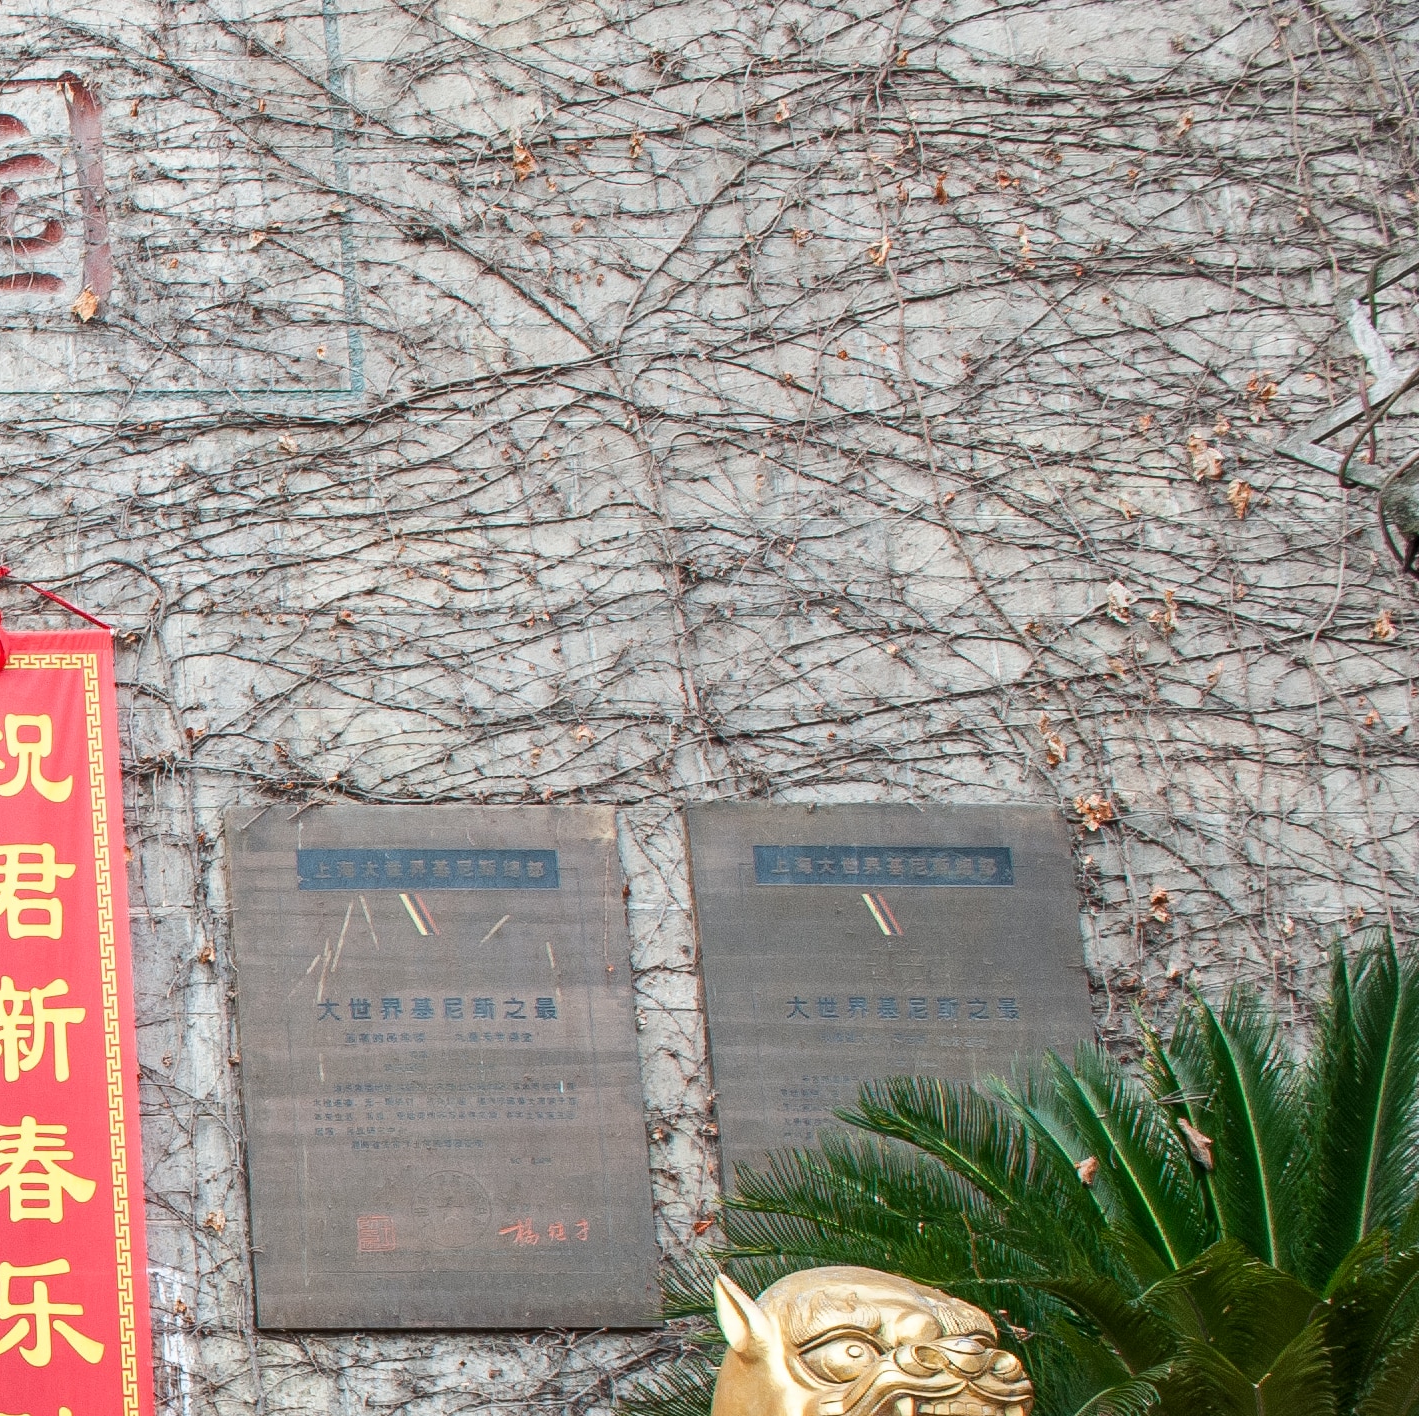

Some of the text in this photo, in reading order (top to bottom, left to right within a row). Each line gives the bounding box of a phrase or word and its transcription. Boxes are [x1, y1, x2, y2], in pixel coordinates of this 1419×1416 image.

[316, 996, 558, 1021] 大世界基尼斯之最
[786, 995, 1021, 1021] 大世界基尼斯之最
